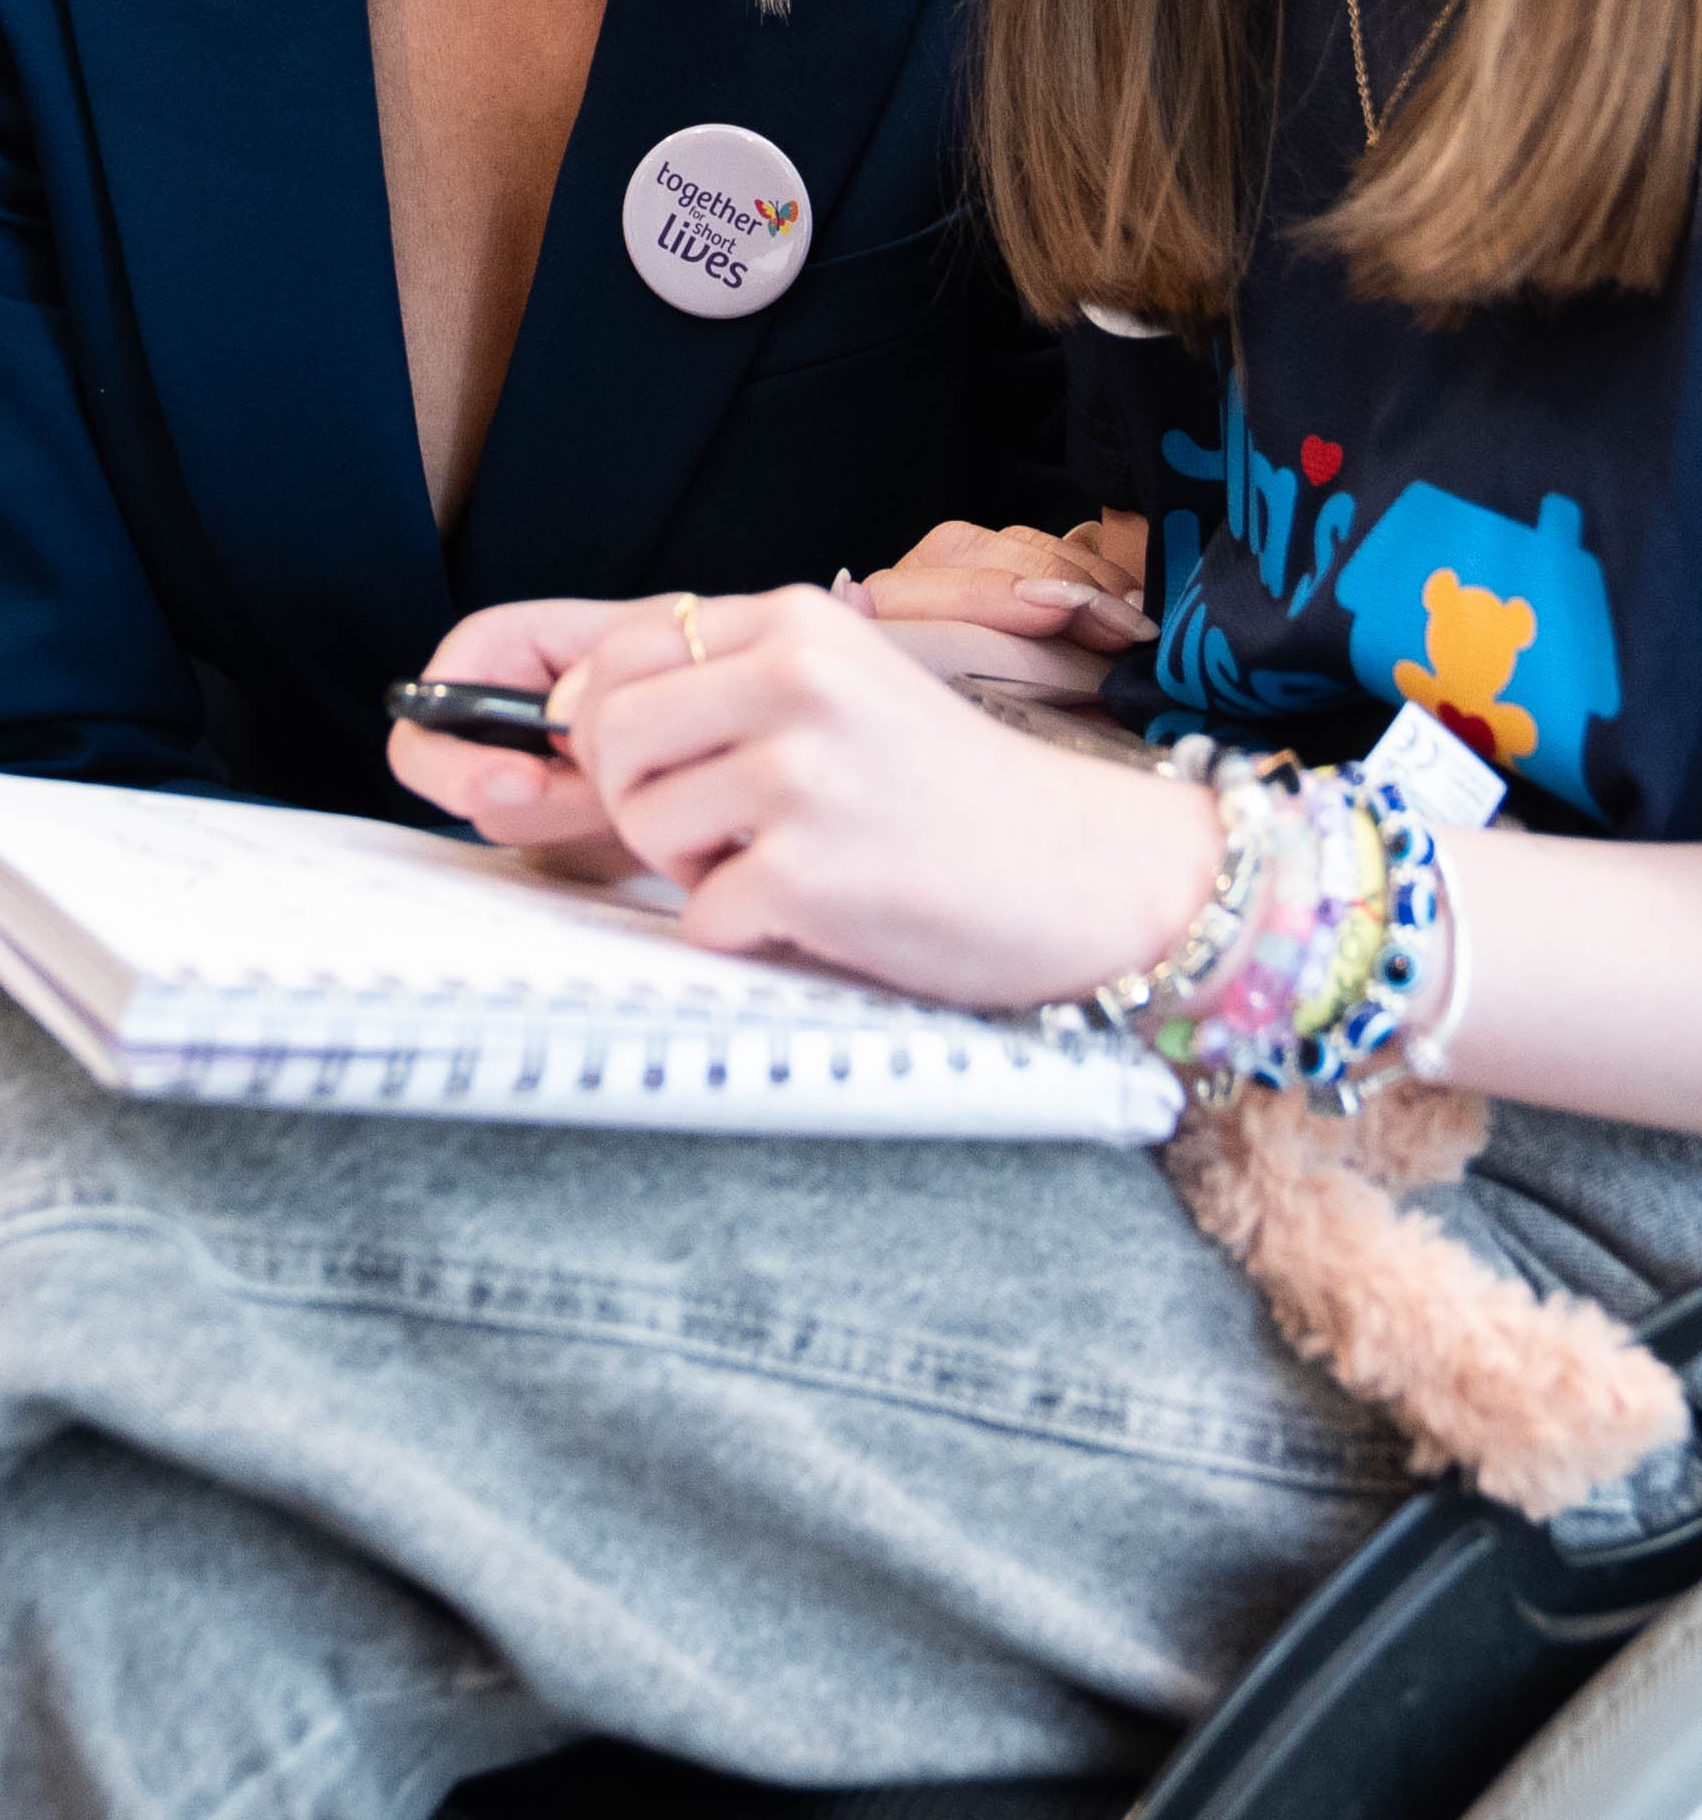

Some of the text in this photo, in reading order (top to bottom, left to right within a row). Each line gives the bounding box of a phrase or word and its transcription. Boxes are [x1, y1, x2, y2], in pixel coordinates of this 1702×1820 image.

[656, 161, 763, 235] together
[688, 204, 706, 222] for
[657, 213, 748, 289] lives
[691, 220, 737, 254] short
